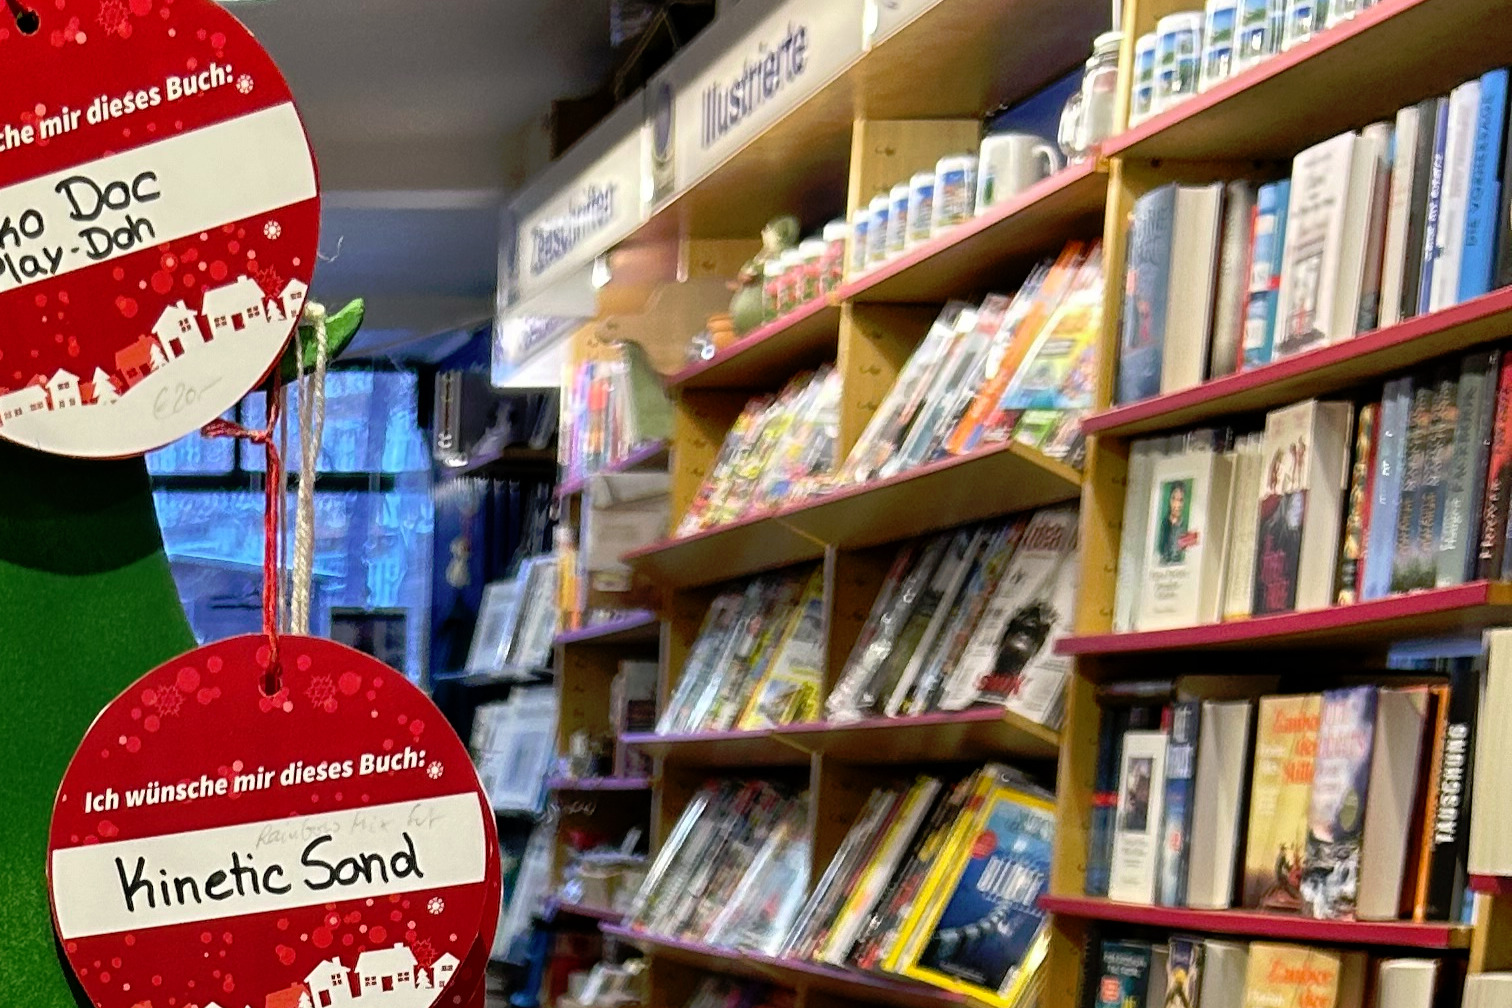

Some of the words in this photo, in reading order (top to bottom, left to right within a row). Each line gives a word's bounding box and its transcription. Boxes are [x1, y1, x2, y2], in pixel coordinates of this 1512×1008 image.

[40, 107, 82, 138] mir
[86, 84, 161, 124] dieses
[166, 64, 234, 99] Buch:
[55, 169, 161, 223] Doc
[85, 791, 119, 813] Ich
[125, 777, 228, 809] wünsche
[233, 767, 276, 793] mir
[280, 757, 353, 785] dieses
[359, 749, 427, 776] Buch:
[115, 853, 291, 912] Kinetic
[301, 833, 424, 891] Sand
